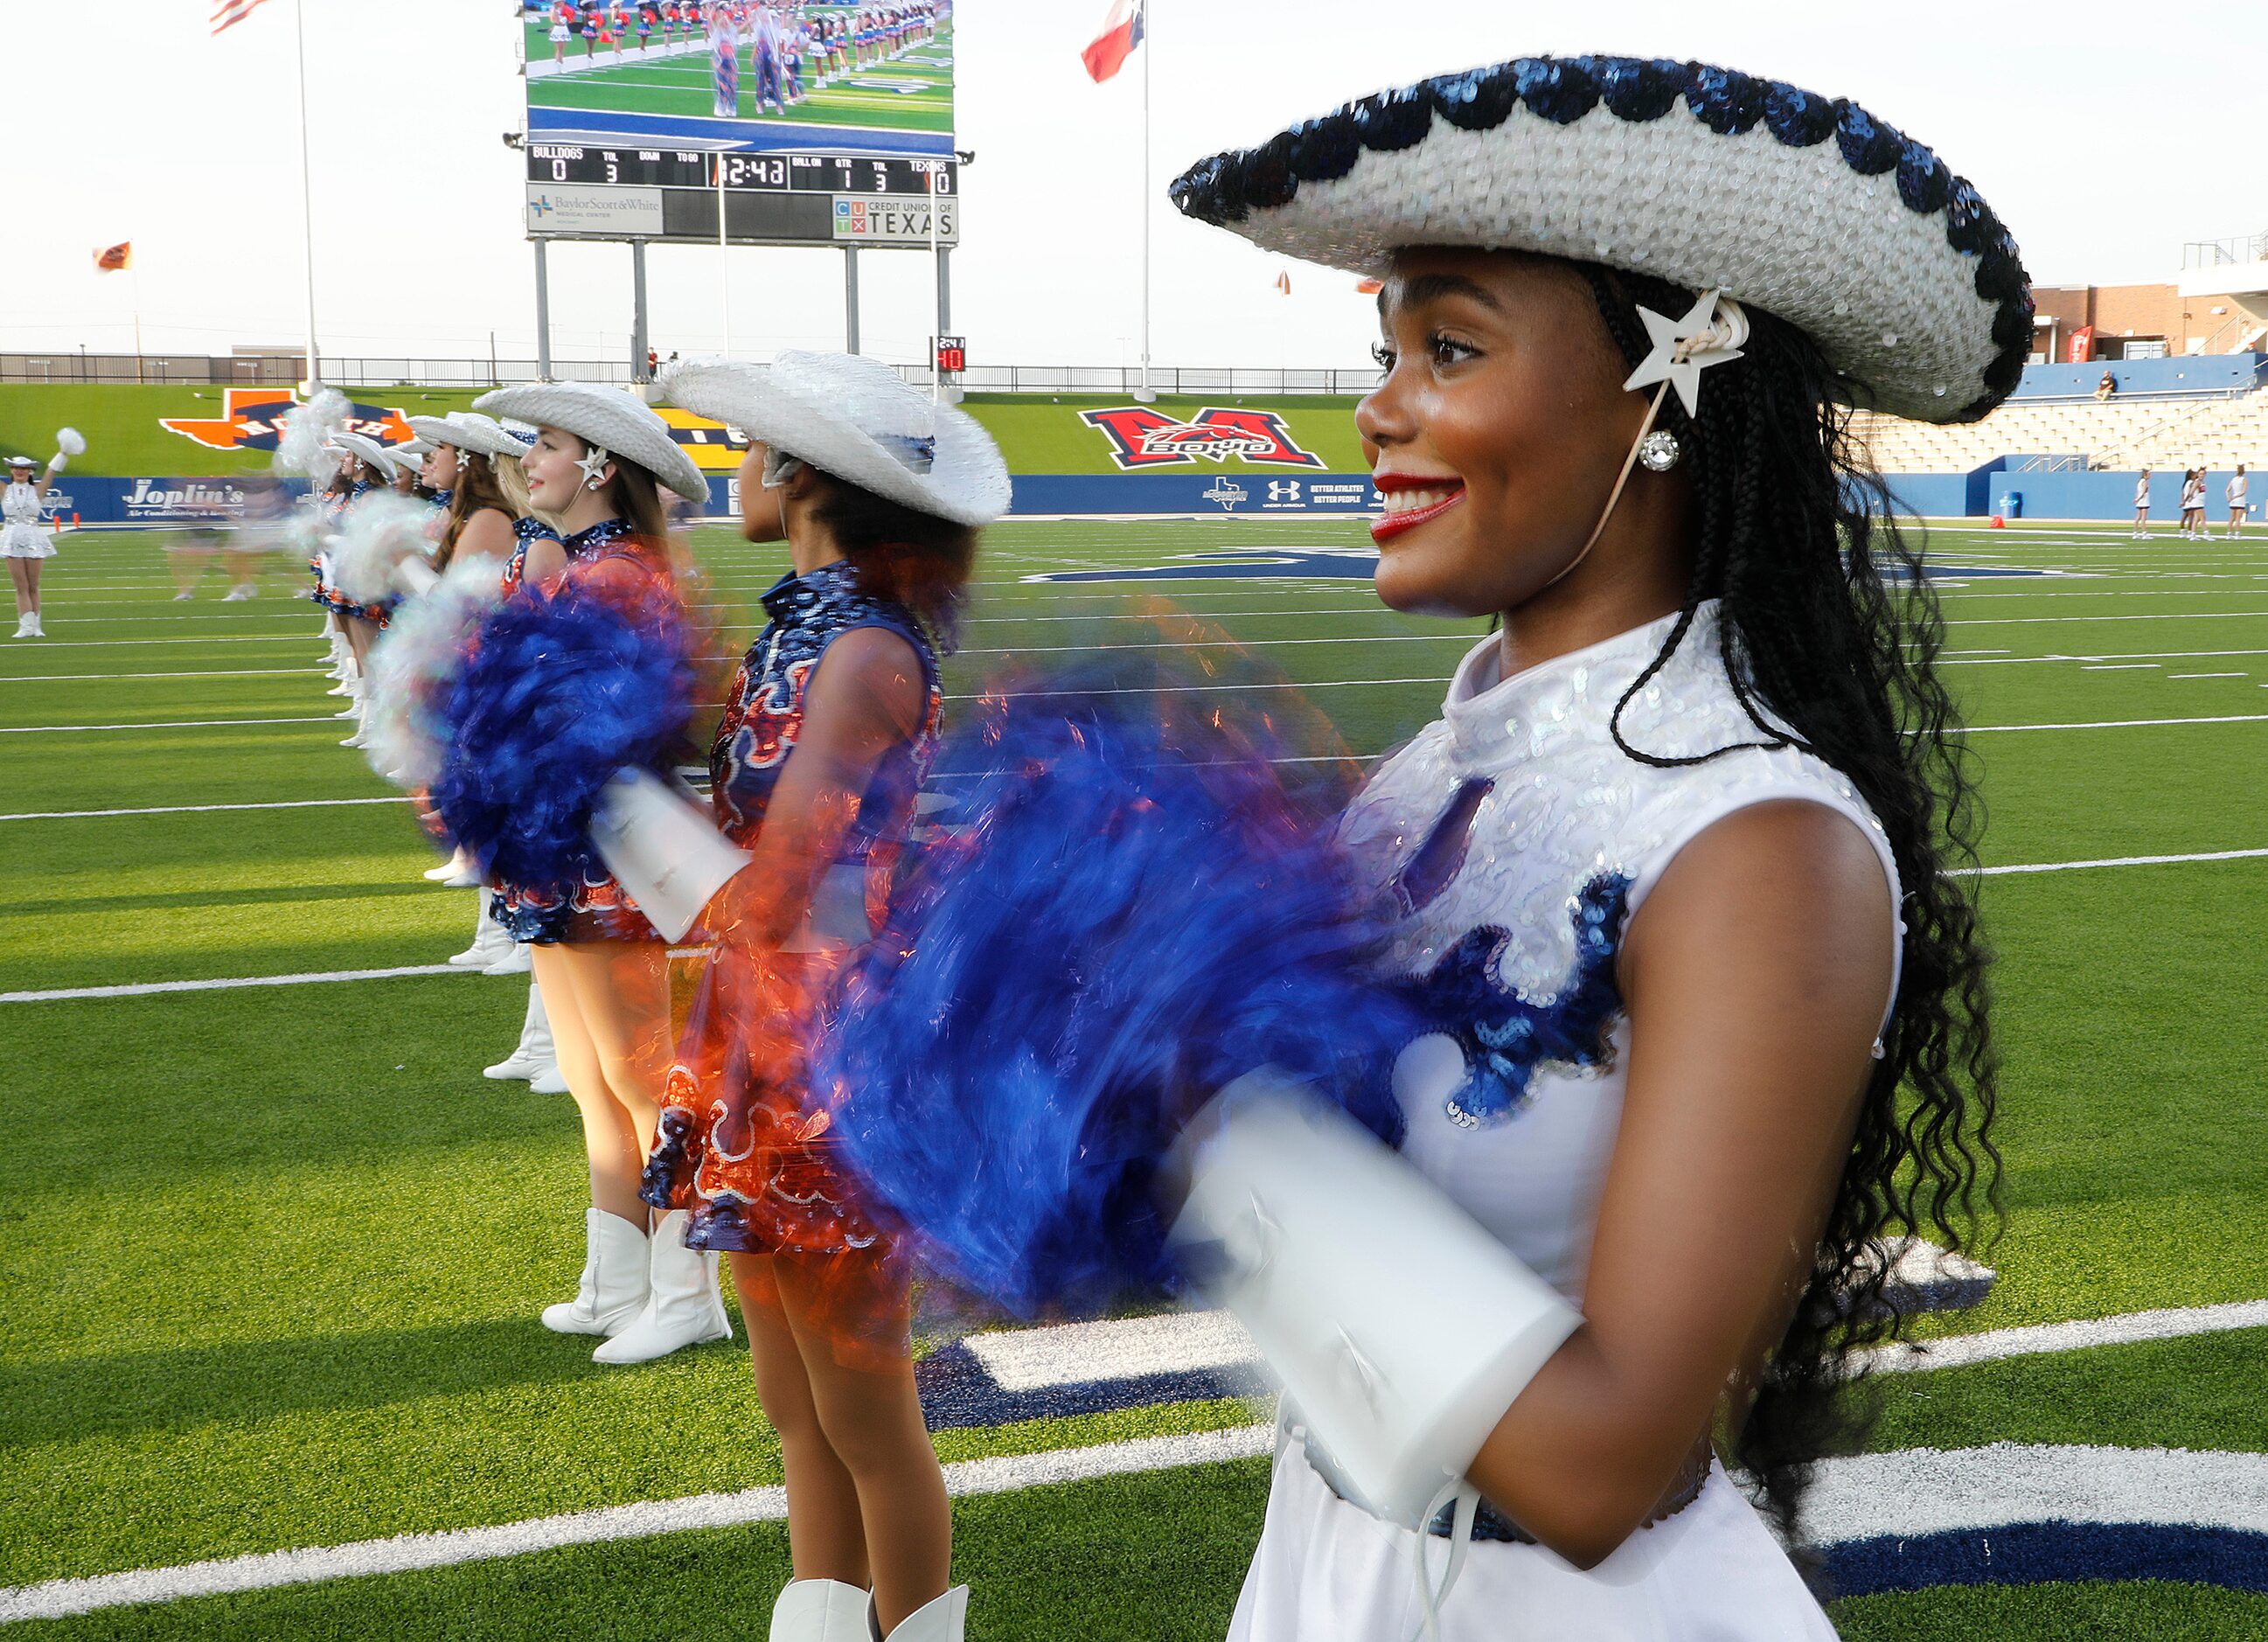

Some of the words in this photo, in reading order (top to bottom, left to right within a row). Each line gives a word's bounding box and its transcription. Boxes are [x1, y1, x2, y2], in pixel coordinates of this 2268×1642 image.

[532, 146, 583, 160] BULLDOGS
[602, 151, 619, 162] TOL
[639, 151, 660, 161] DOWN
[677, 152, 687, 162] TO
[792, 157, 810, 167] BALL
[811, 158, 821, 167] ON
[835, 159, 852, 168] QTR
[872, 162, 887, 171] TOL
[909, 161, 946, 172] TEXNS
[552, 159, 567, 181] 0
[606, 164, 617, 183] 3
[845, 170, 851, 188] 1
[876, 174, 886, 191] 3
[936, 173, 950, 193] 0
[868, 202, 900, 212] CREDIT
[939, 204, 952, 213] OF
[868, 212, 952, 235] TEXAS
[234, 418, 393, 436] NTH
[122, 484, 245, 510] Joplin's
